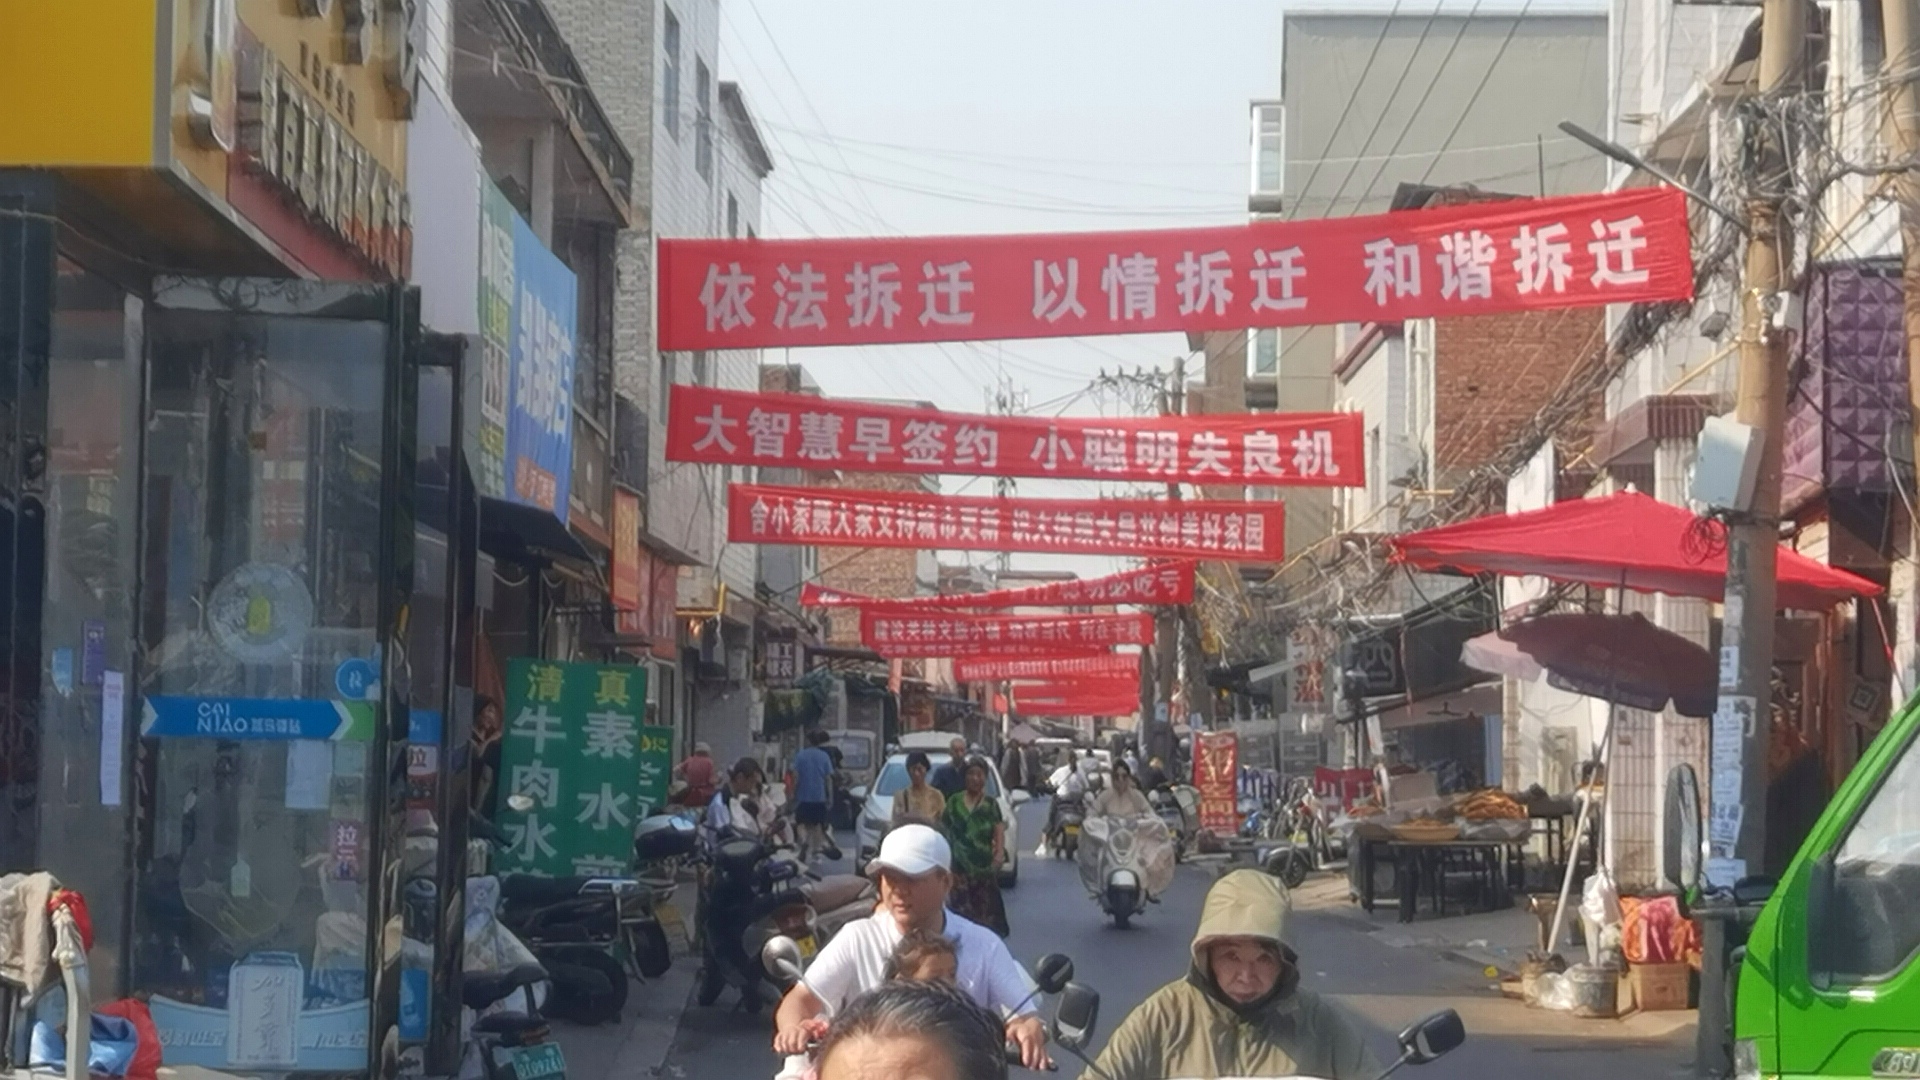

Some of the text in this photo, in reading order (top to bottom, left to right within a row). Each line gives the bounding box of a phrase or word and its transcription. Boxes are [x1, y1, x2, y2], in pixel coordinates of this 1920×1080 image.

[698, 214, 1652, 332] 依法拆迁 以情拆迁 和谐拆迁
[692, 404, 1340, 478] 大智慧早签约 小聪明失良机
[750, 495, 1000, 541] 舍小家顾大家支持城市更新
[197, 717, 248, 733] NIAO
